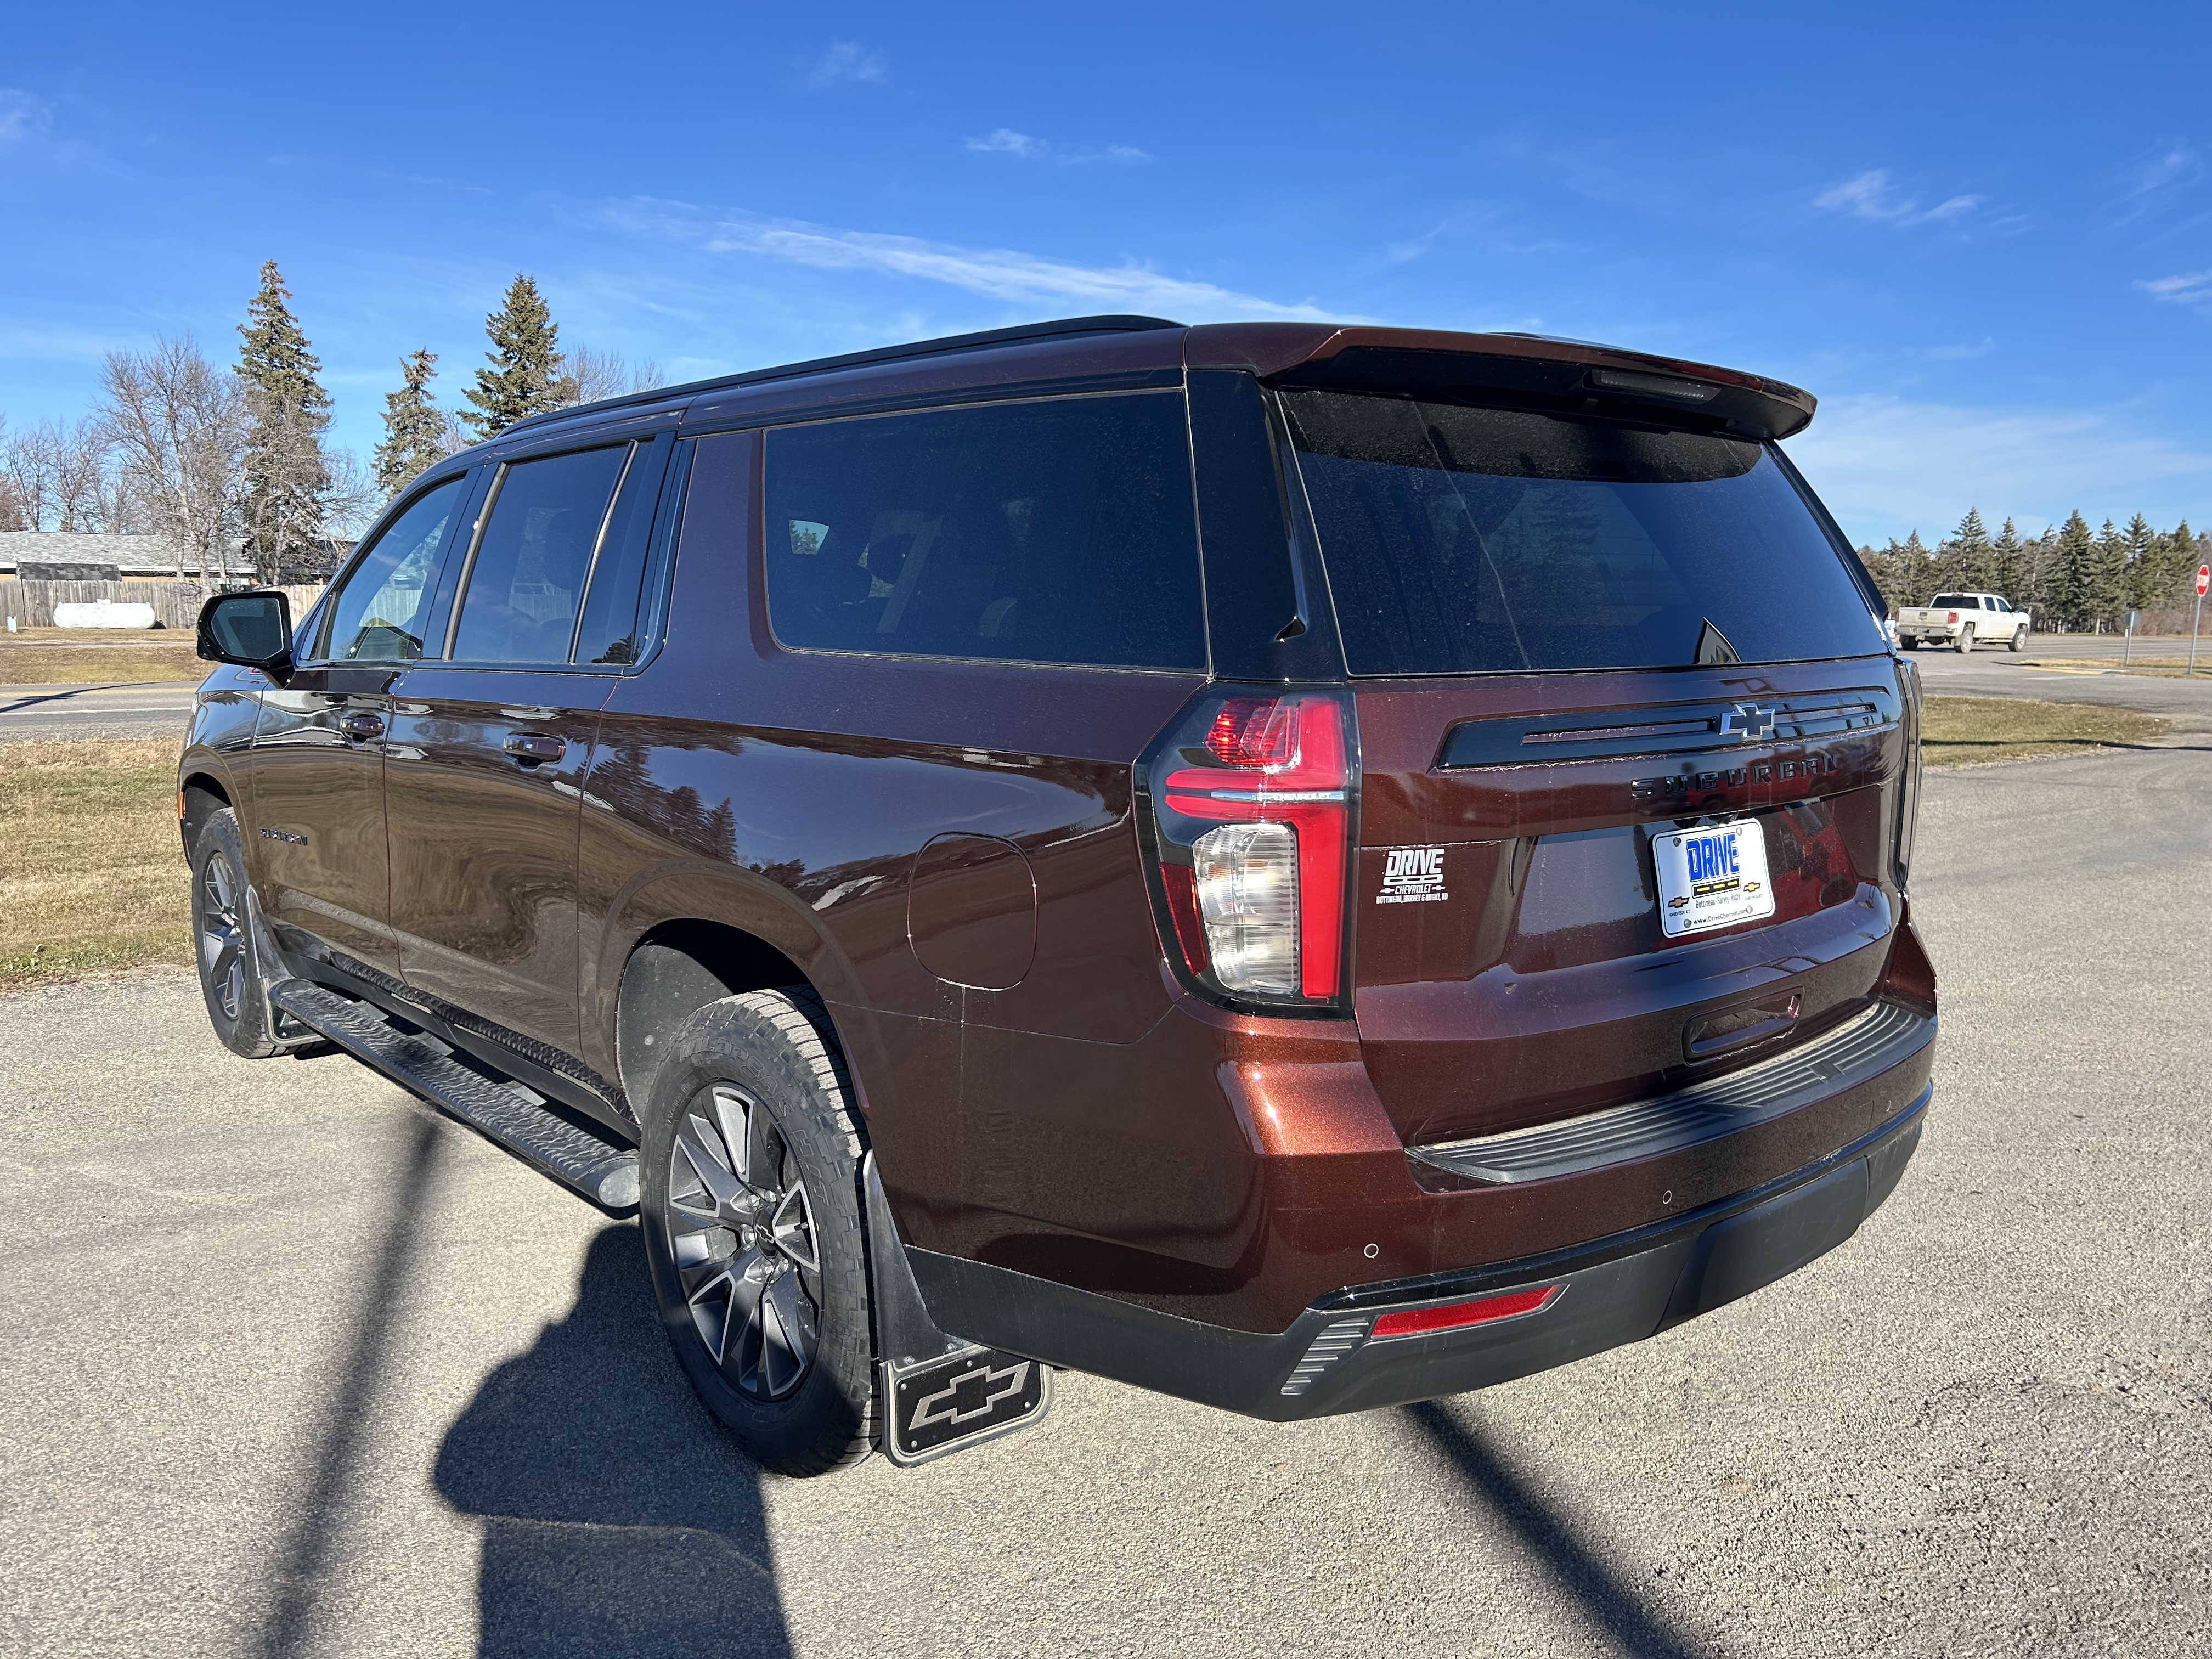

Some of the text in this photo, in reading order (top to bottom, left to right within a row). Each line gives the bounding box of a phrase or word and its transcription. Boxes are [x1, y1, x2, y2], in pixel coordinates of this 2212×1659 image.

[2197, 574, 2209, 587] STOP
[1631, 754, 1838, 799] SUBURBAN
[1385, 849, 1444, 876] DRIVE
[1686, 832, 1740, 883] DRIVE
[1395, 884, 1432, 895] CHEVROLET
[1669, 909, 1690, 917] CHEVROLET
[676, 1035, 795, 1118] WILDPEAK
